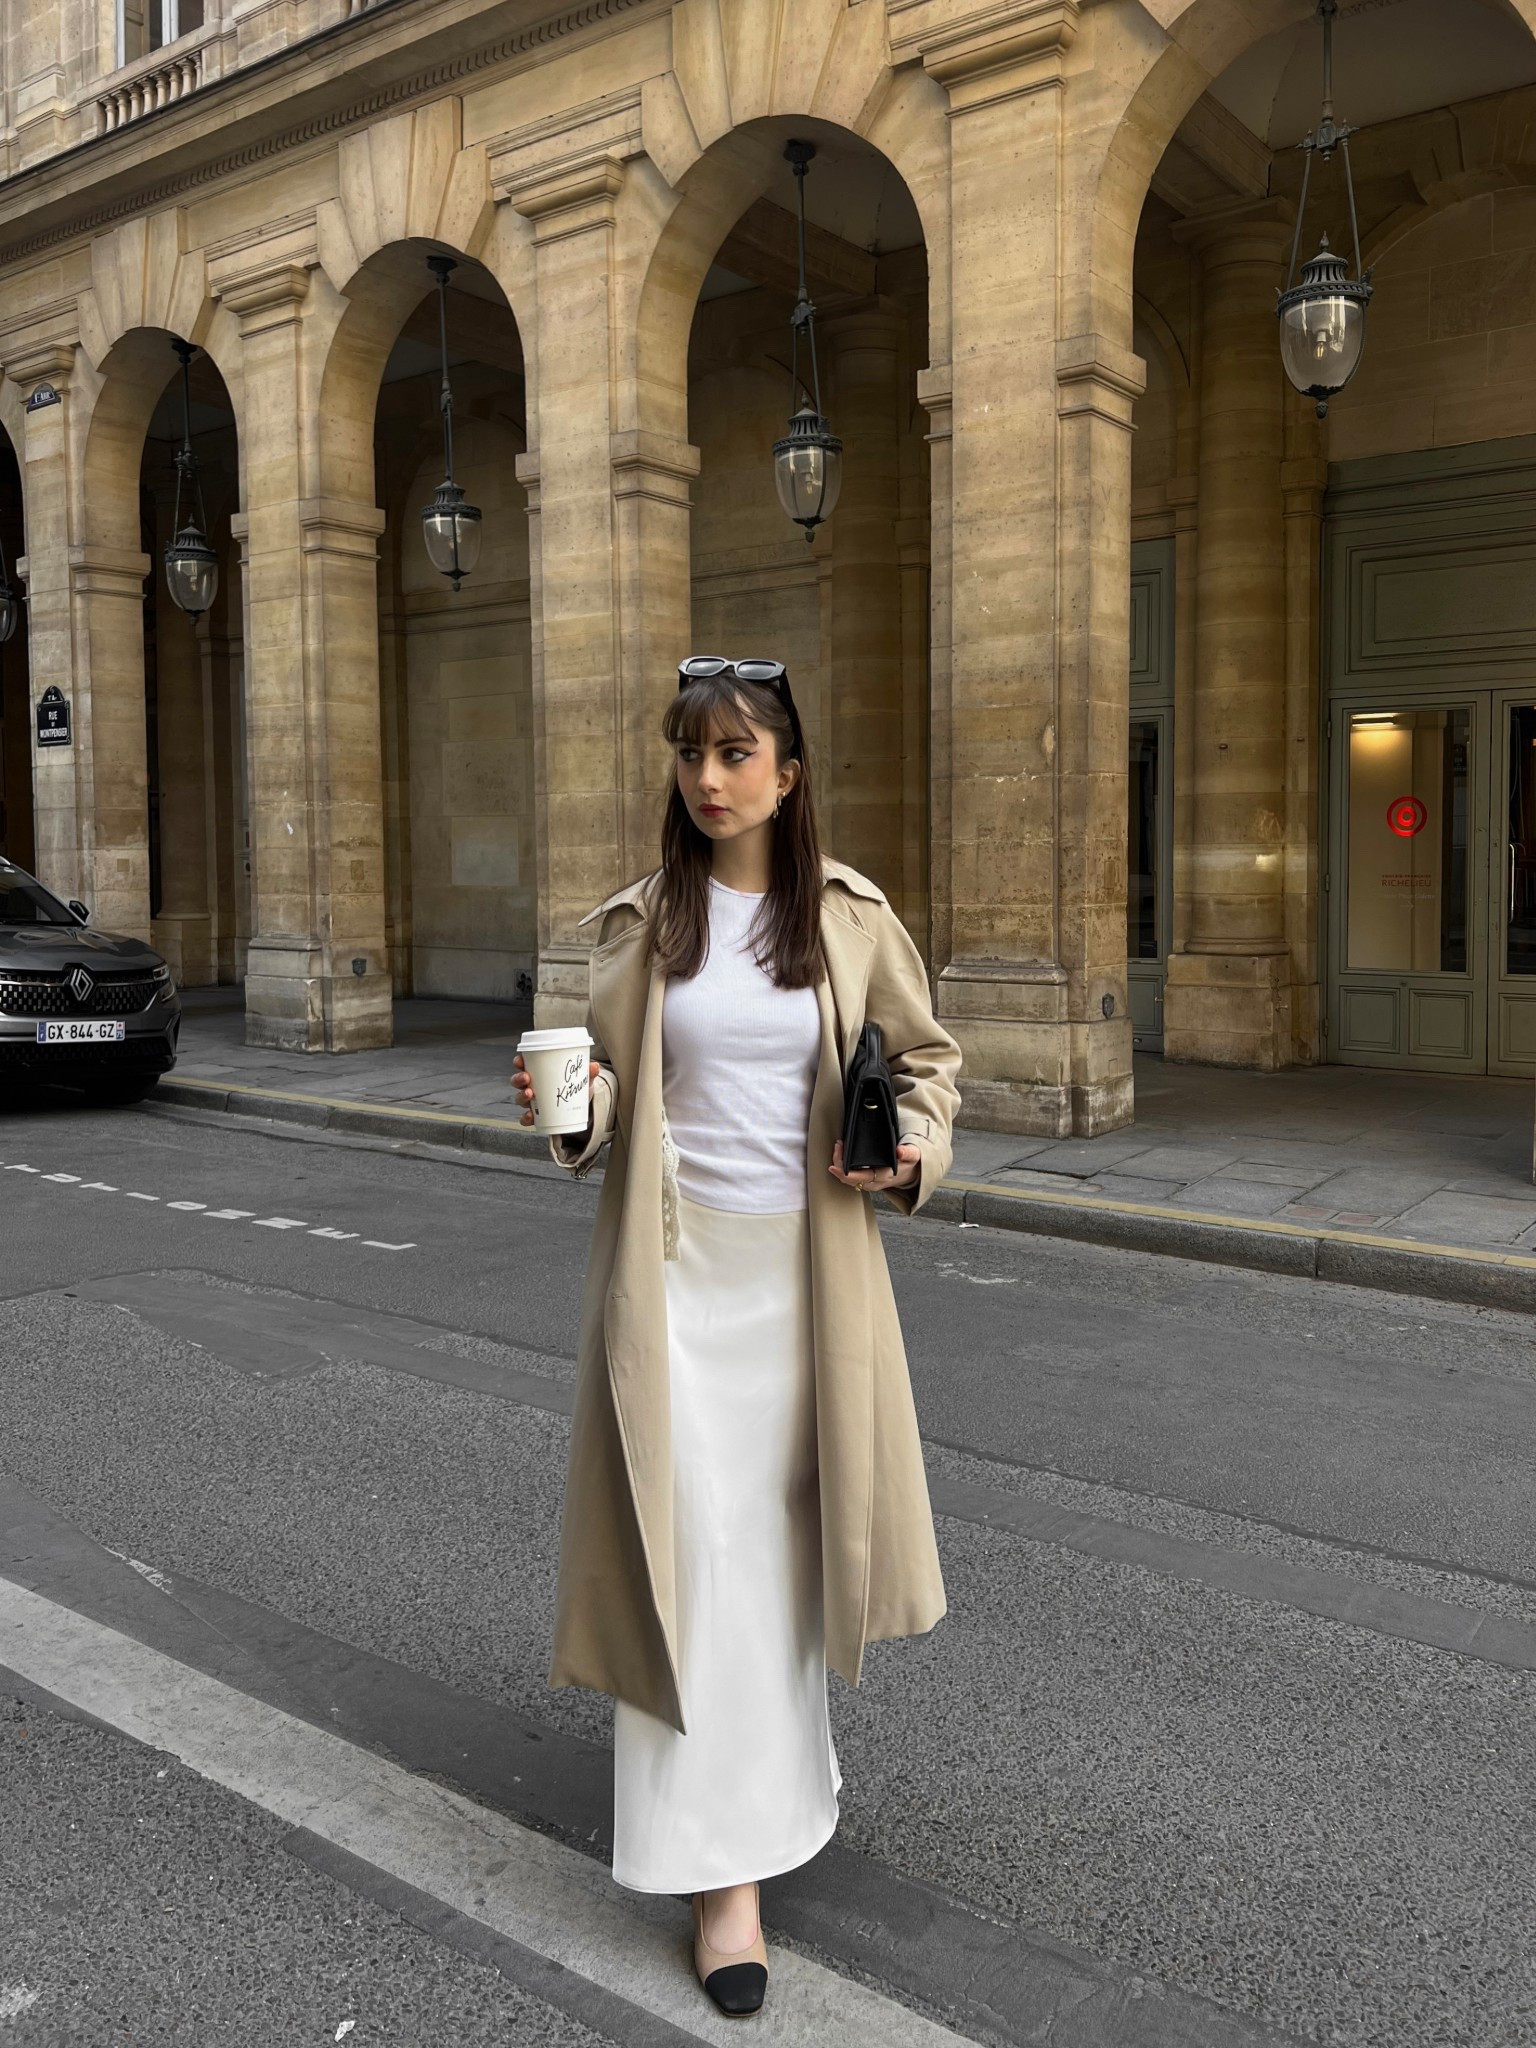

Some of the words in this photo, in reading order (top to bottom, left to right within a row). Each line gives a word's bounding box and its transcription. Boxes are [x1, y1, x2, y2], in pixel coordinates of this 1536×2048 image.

[48, 710, 58, 720] RUE
[1381, 879, 1431, 887] RICHELIEU
[47, 1023, 115, 1040] GX-844-GZ
[564, 1054, 583, 1083] Café
